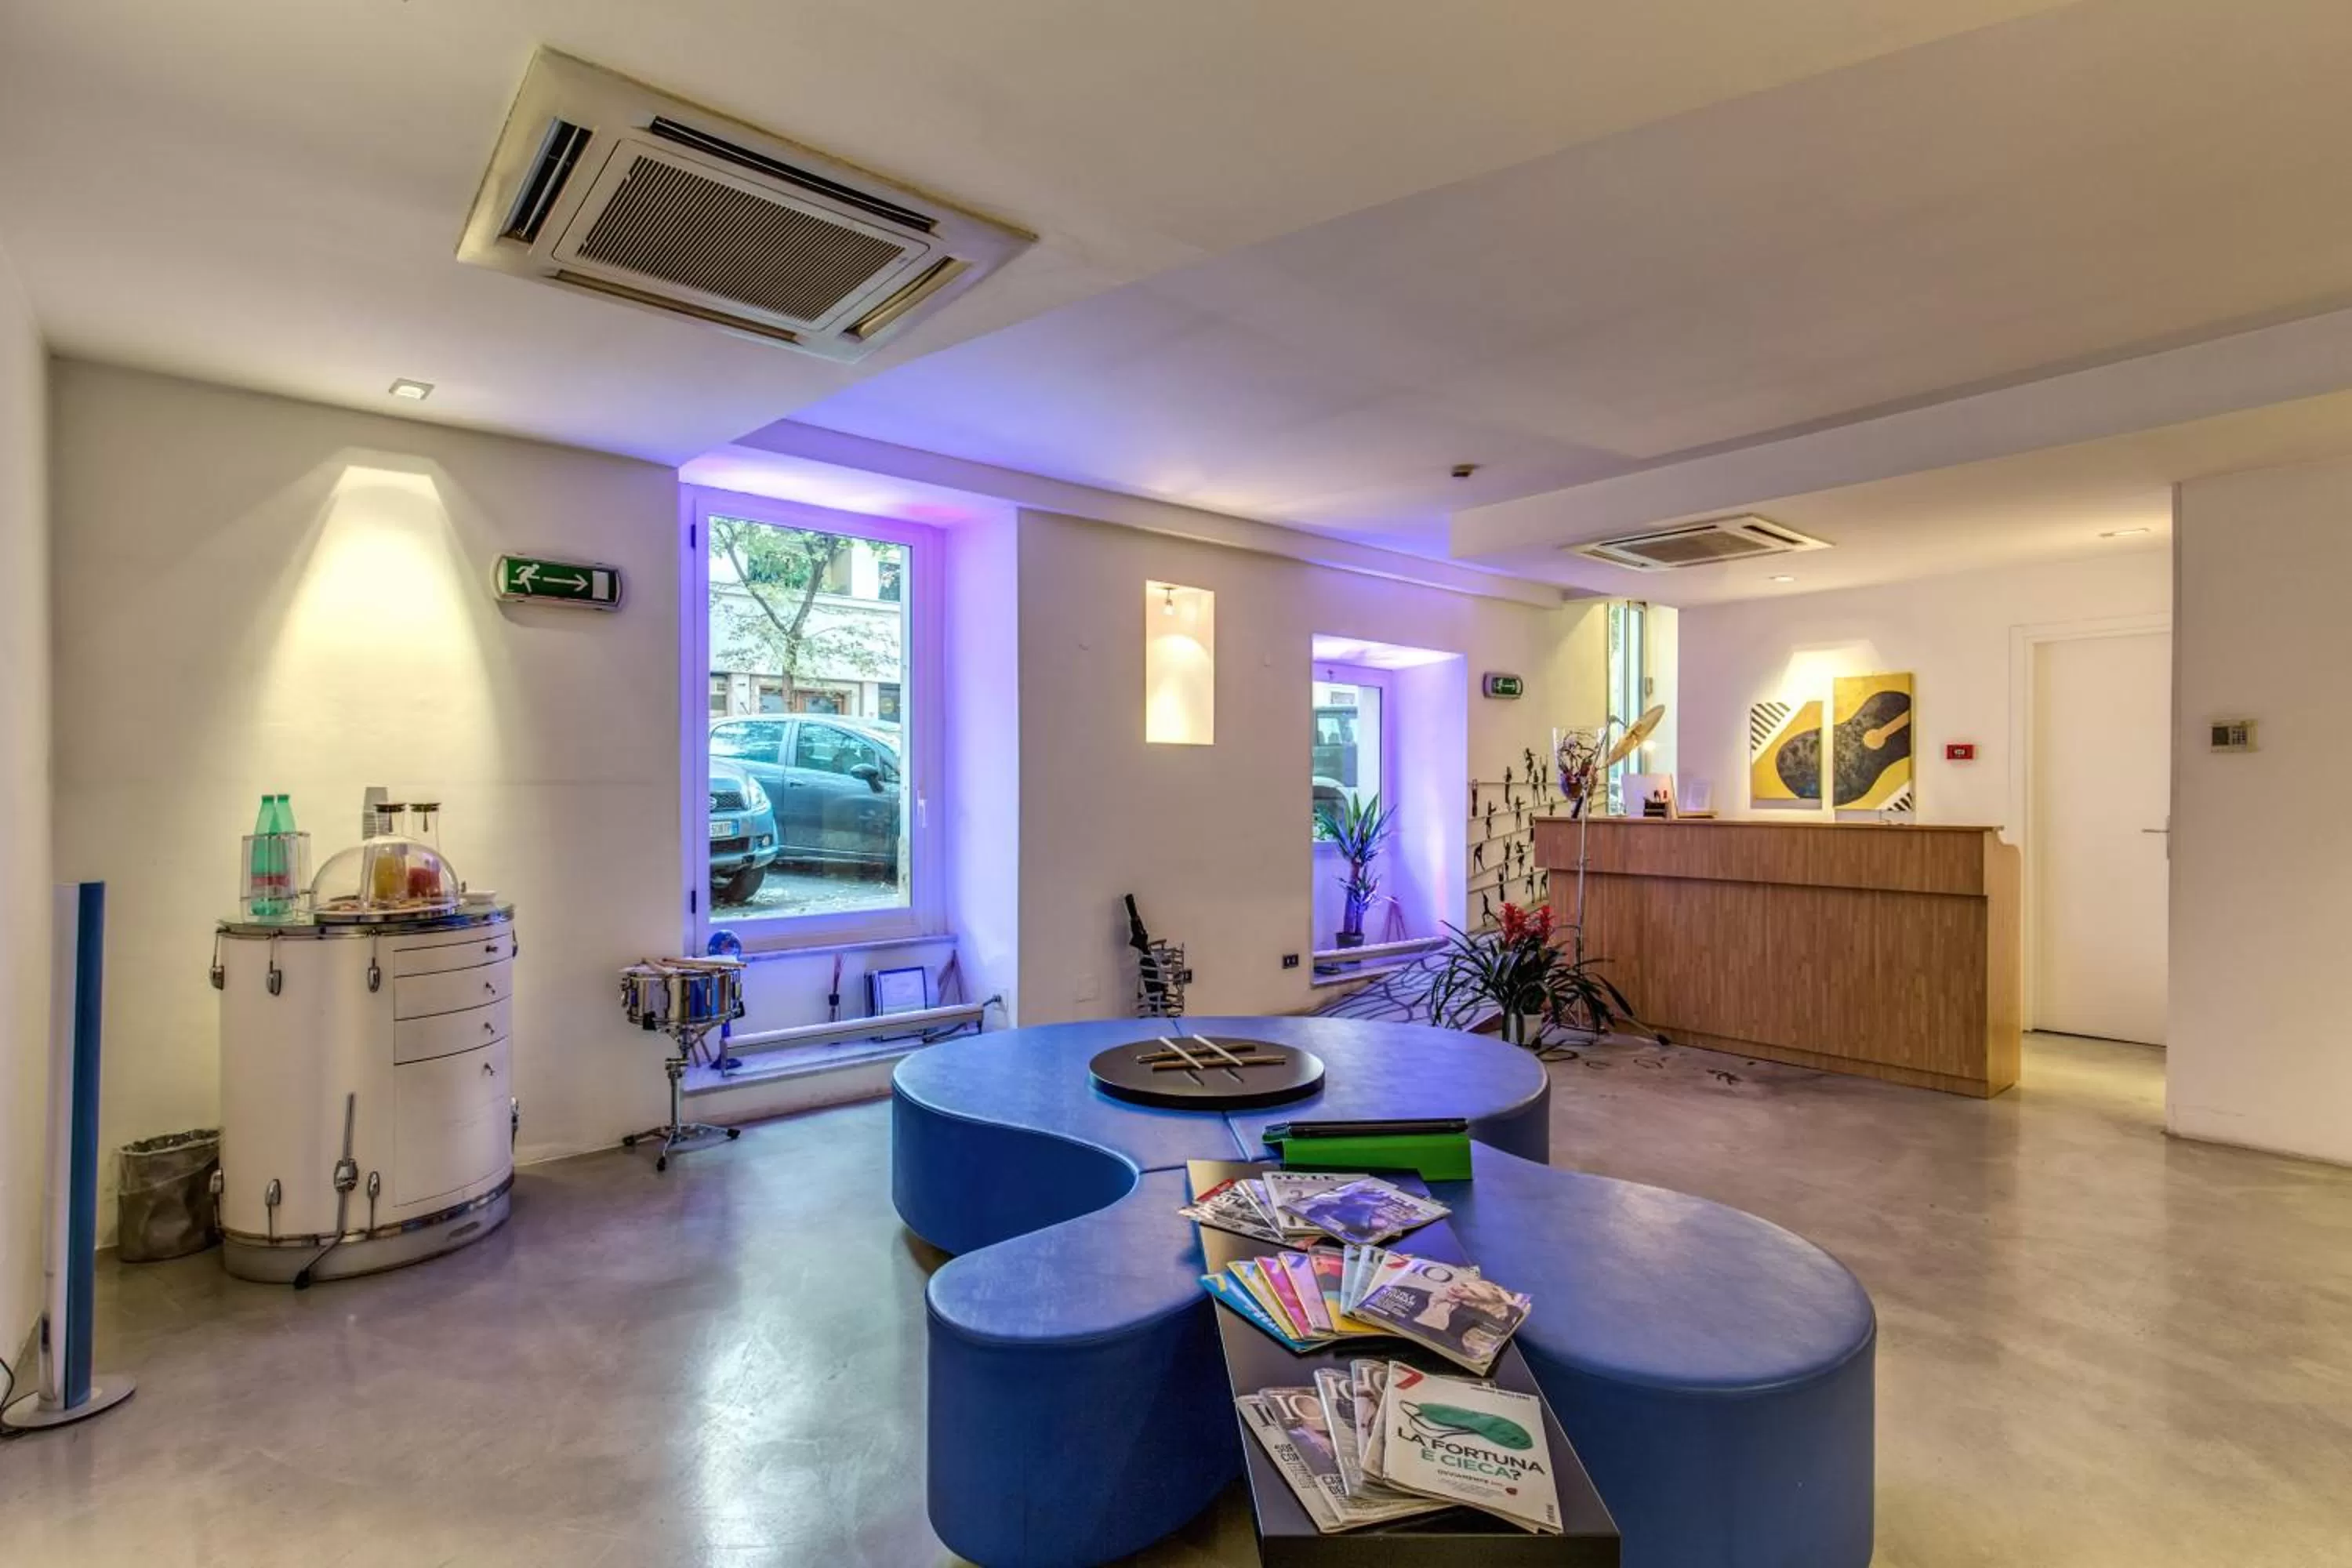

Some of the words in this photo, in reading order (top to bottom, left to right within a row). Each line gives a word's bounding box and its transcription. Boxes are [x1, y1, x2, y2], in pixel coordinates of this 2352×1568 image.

[1398, 1426, 1426, 1446] LA
[1431, 1438, 1546, 1475] FORTUNA
[1440, 1454, 1523, 1482] CIECA?
